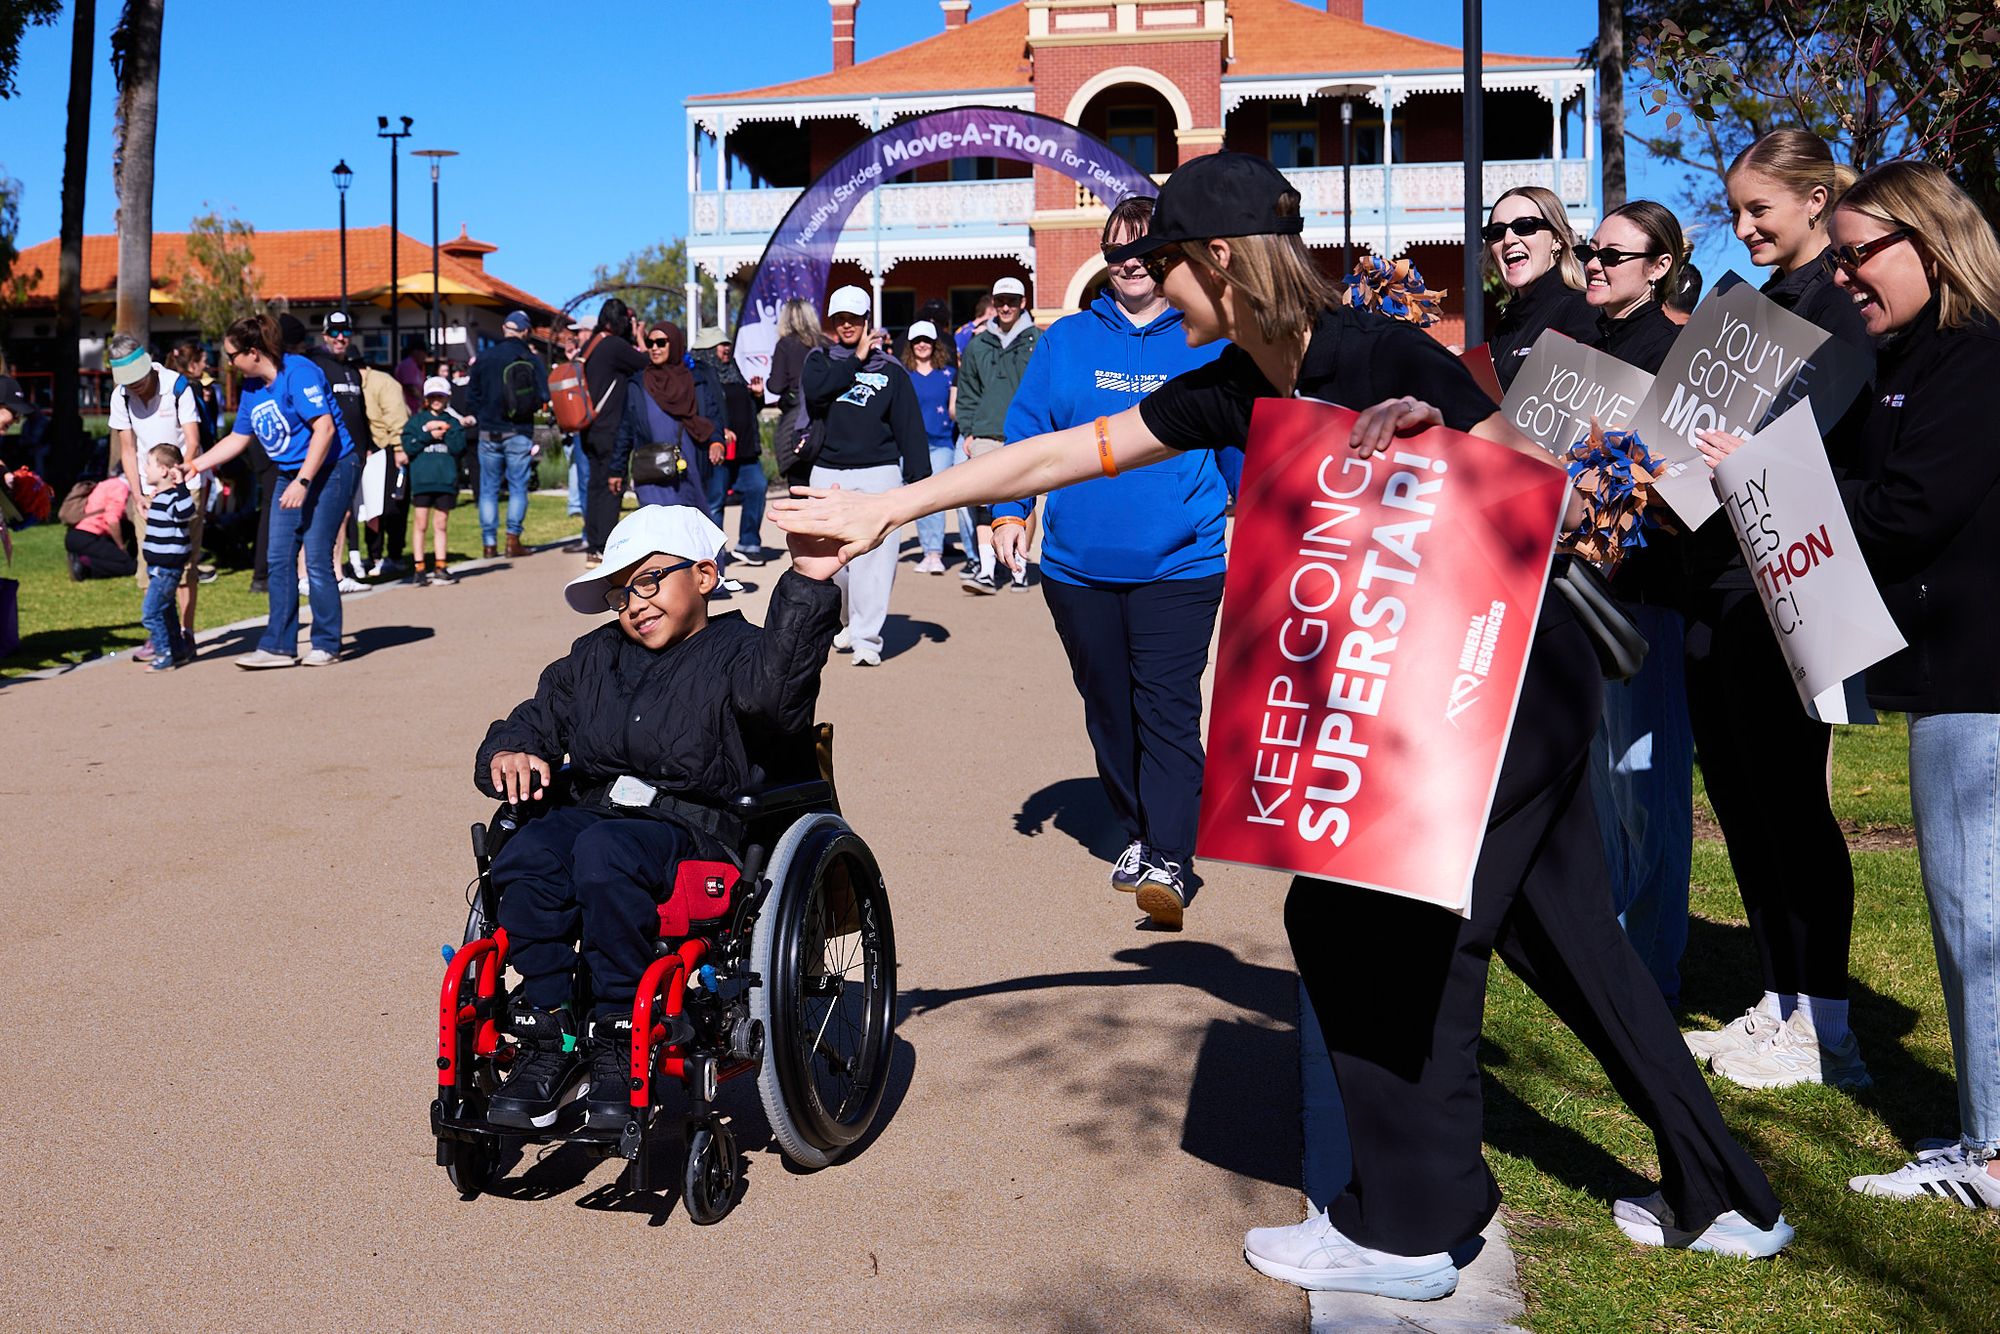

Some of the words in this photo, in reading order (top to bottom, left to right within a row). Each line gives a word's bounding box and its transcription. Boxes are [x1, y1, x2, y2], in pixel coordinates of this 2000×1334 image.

[795, 198, 839, 248] Healthy
[834, 162, 882, 202] Strides
[883, 123, 1058, 167] Move-A-Thon
[1061, 149, 1085, 168] for
[1688, 349, 1746, 408] GOT
[1715, 312, 1816, 400] YOU'VE
[1516, 395, 1571, 443] GOT
[1543, 364, 1635, 430] YOU'VE
[1298, 452, 1448, 847] SUPERSTAR!
[1458, 614, 1487, 672] MINERAL
[1473, 600, 1506, 677] RESOURCES
[1247, 675, 1310, 826] KEEP
[515, 1015, 536, 1025] FILA
